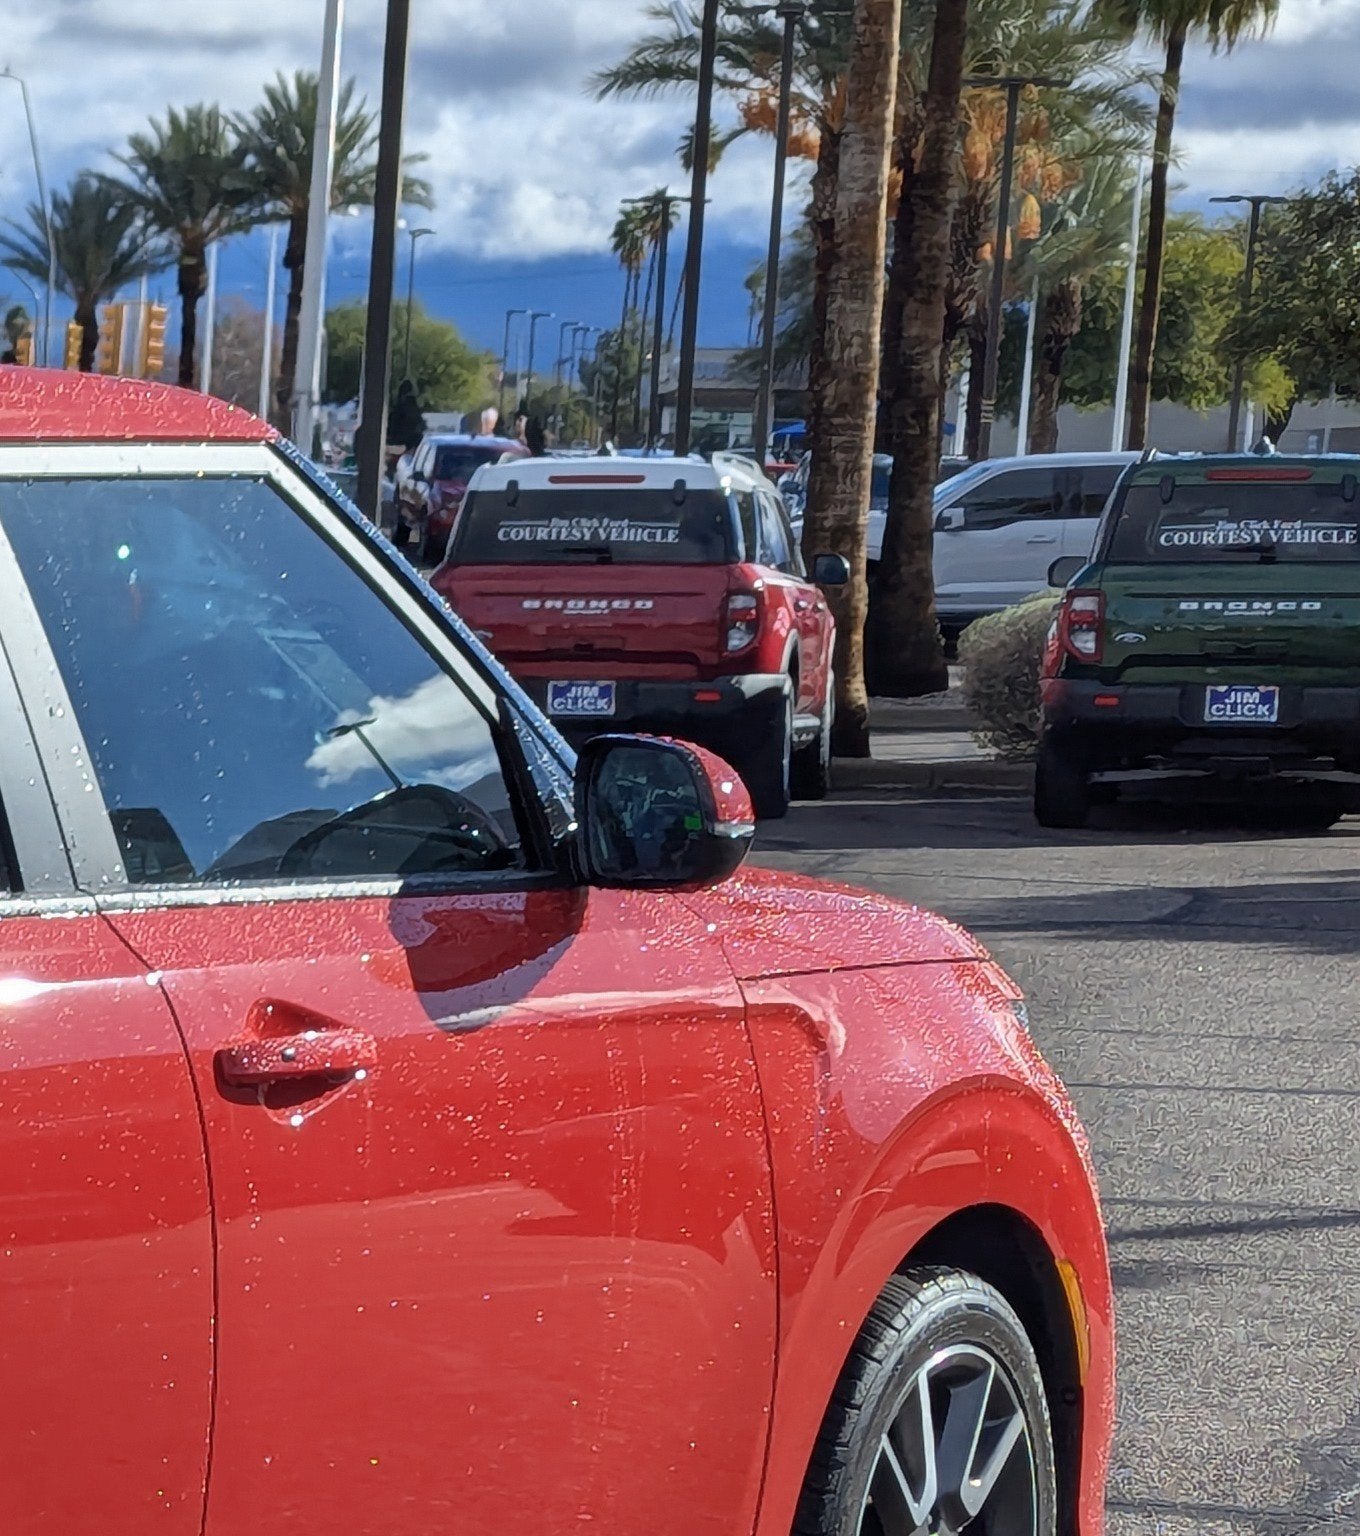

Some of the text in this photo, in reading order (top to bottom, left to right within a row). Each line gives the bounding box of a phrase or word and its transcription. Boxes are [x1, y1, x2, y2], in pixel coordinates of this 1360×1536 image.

[497, 526, 680, 543] COURTESY VEHICLE
[1159, 529, 1358, 546] COURTESY VEHICLE
[566, 686, 600, 698] JIM
[1224, 691, 1260, 704] JIM
[553, 697, 610, 711] CLICK
[1210, 703, 1271, 716] CLICK
